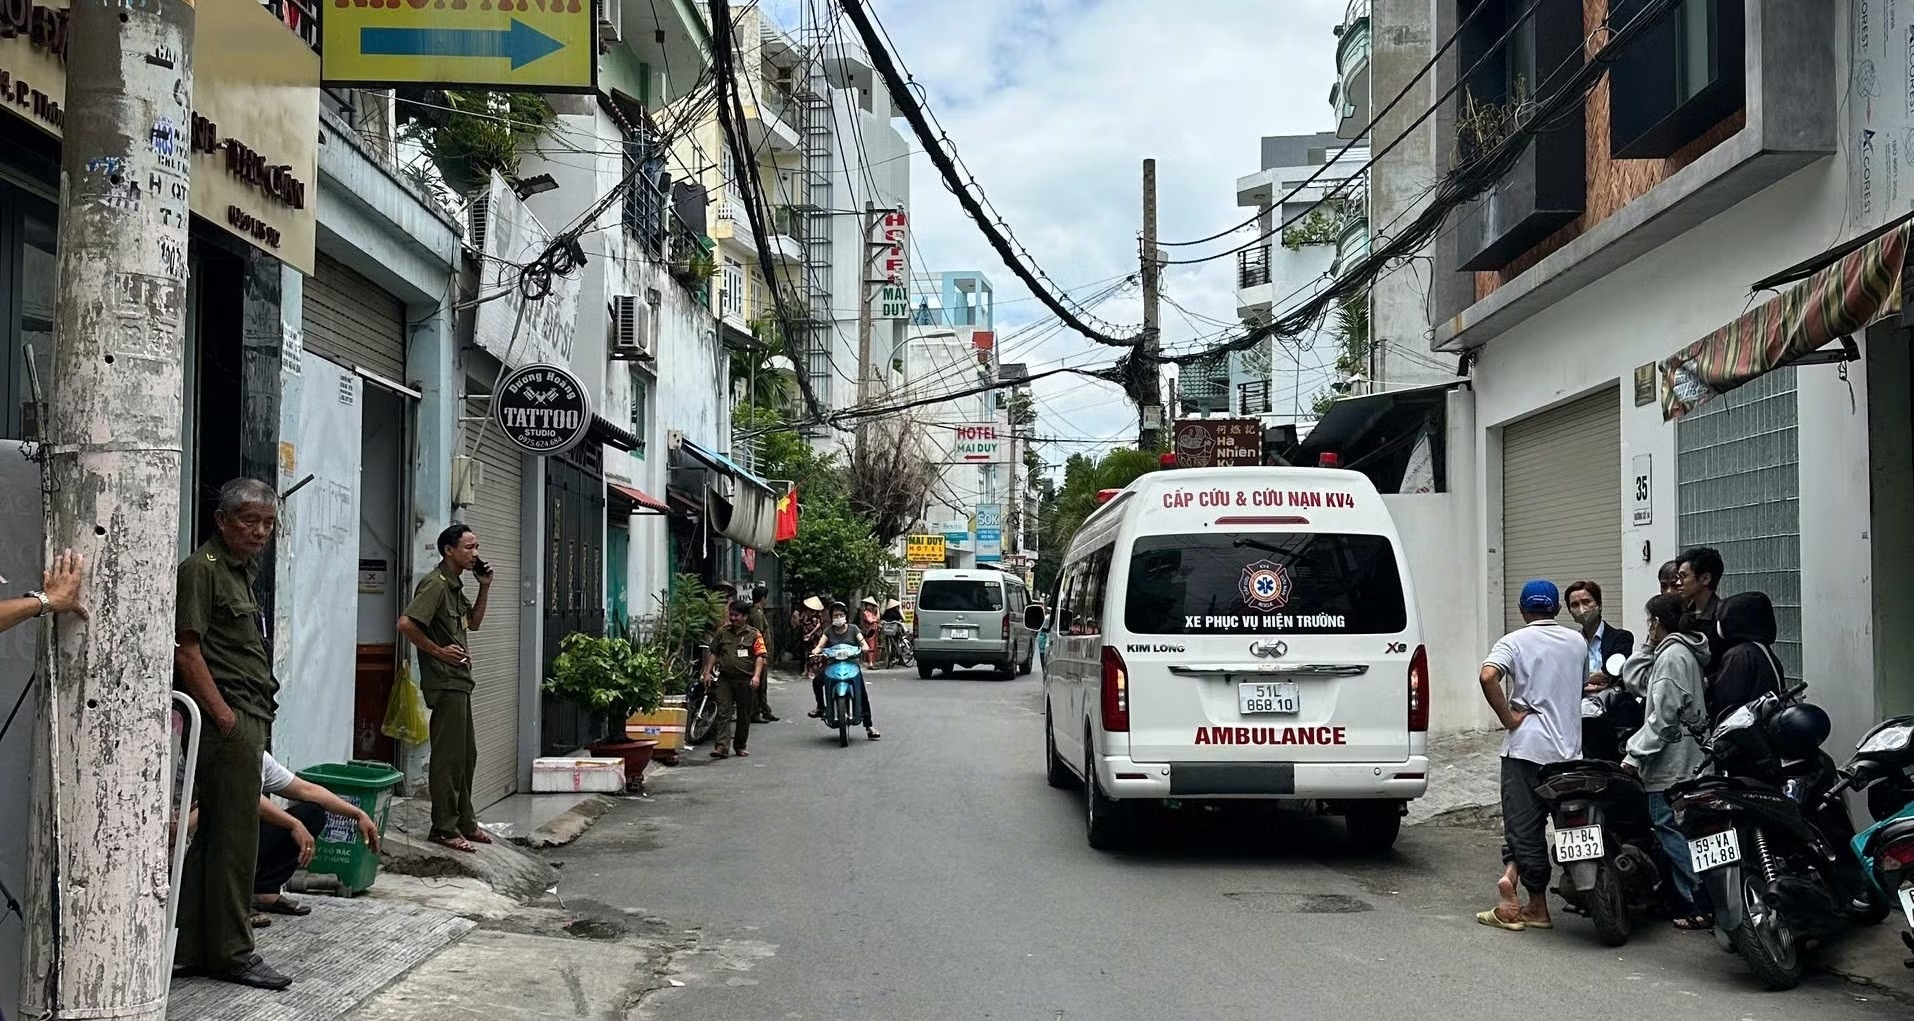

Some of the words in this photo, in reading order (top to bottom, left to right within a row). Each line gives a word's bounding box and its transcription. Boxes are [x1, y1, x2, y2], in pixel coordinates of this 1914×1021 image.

[883, 287, 907, 301] MAI
[883, 303, 907, 317] DUY
[508, 372, 542, 394] Dương
[504, 407, 578, 429] TATTOO
[524, 428, 556, 437] STUDIO
[957, 426, 998, 440] HOTEL
[1216, 435, 1235, 446] Hà
[957, 443, 975, 453] MAI
[978, 443, 998, 453] DUY
[1216, 446, 1256, 458] Nhiên
[1635, 475, 1648, 501] 35
[1163, 487, 1193, 508] CẤP
[1199, 488, 1230, 507] CỨU
[1236, 491, 1247, 506] &
[1252, 487, 1284, 507] CỨU
[1288, 491, 1321, 510] NẠN
[1326, 492, 1355, 508] KV4
[909, 536, 924, 545] MAI
[926, 536, 943, 545] DUY
[1185, 615, 1201, 628] XE
[1205, 615, 1239, 630] PHỤC
[1242, 615, 1259, 630] VỤ
[1262, 613, 1293, 630] HIỆN
[1296, 612, 1346, 628] TRƯỜNG
[1126, 644, 1151, 653] KIM
[1153, 644, 1185, 653] LONG
[1256, 685, 1282, 698] 51L
[1247, 699, 1293, 711] 868.10
[1194, 726, 1346, 745] AMBULANCE
[1561, 829, 1594, 845] 71-B4
[1695, 833, 1730, 854] 59-VA
[1560, 842, 1600, 860] 503.32
[1696, 846, 1735, 869] 114.88
